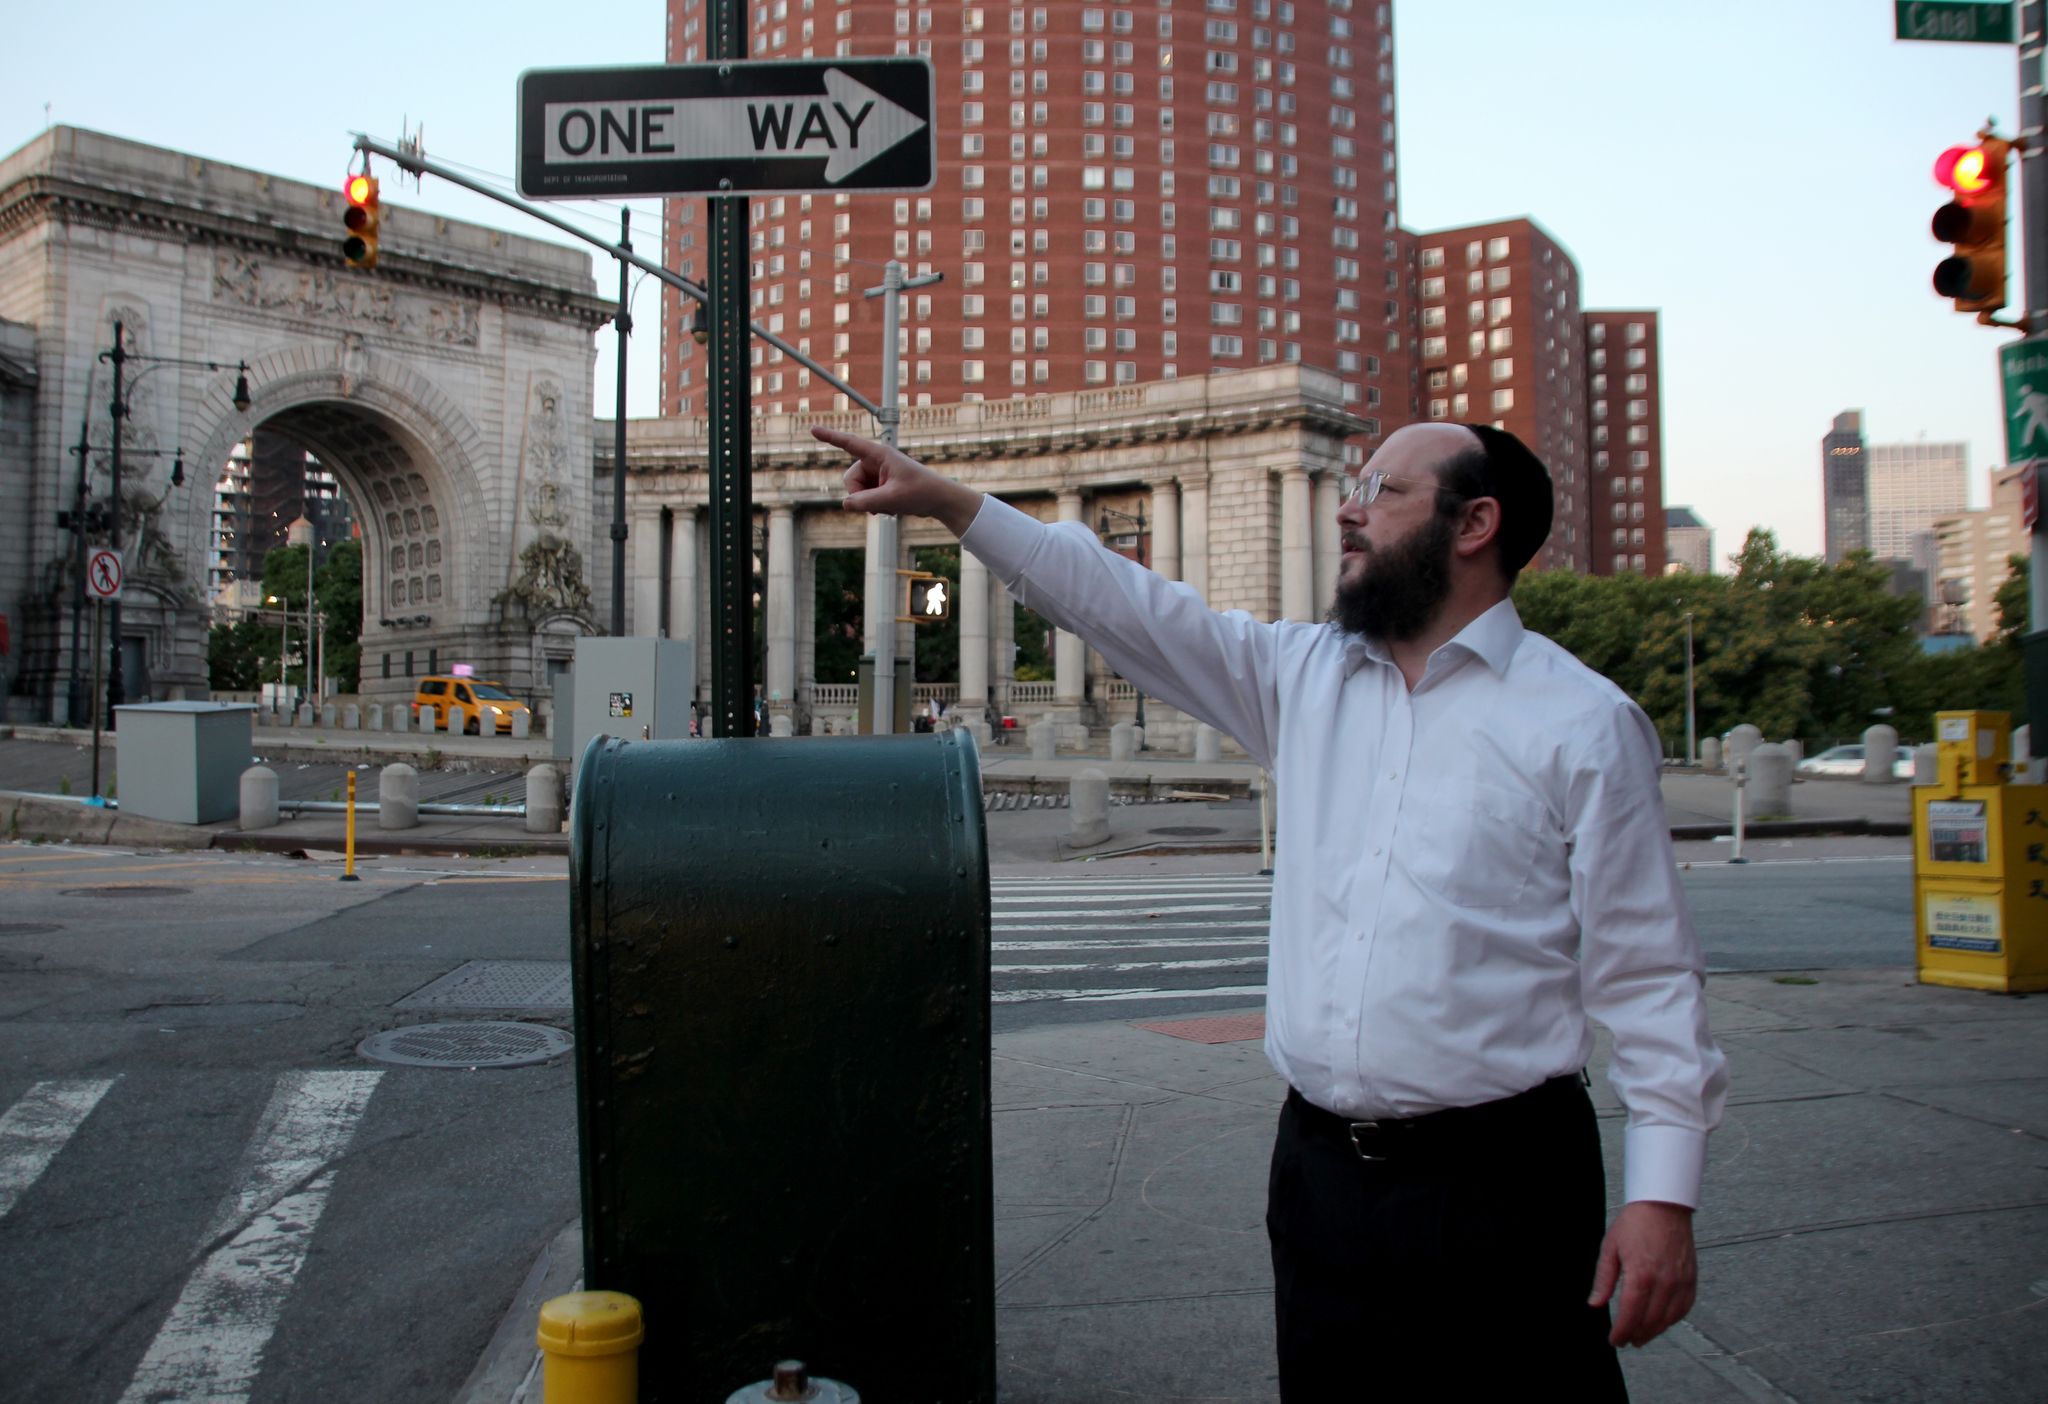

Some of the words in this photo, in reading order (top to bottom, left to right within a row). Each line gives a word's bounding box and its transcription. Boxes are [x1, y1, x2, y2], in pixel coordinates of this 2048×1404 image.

[1907, 2, 1977, 37] Canal
[558, 106, 675, 156] ONE
[747, 101, 875, 152] WAY
